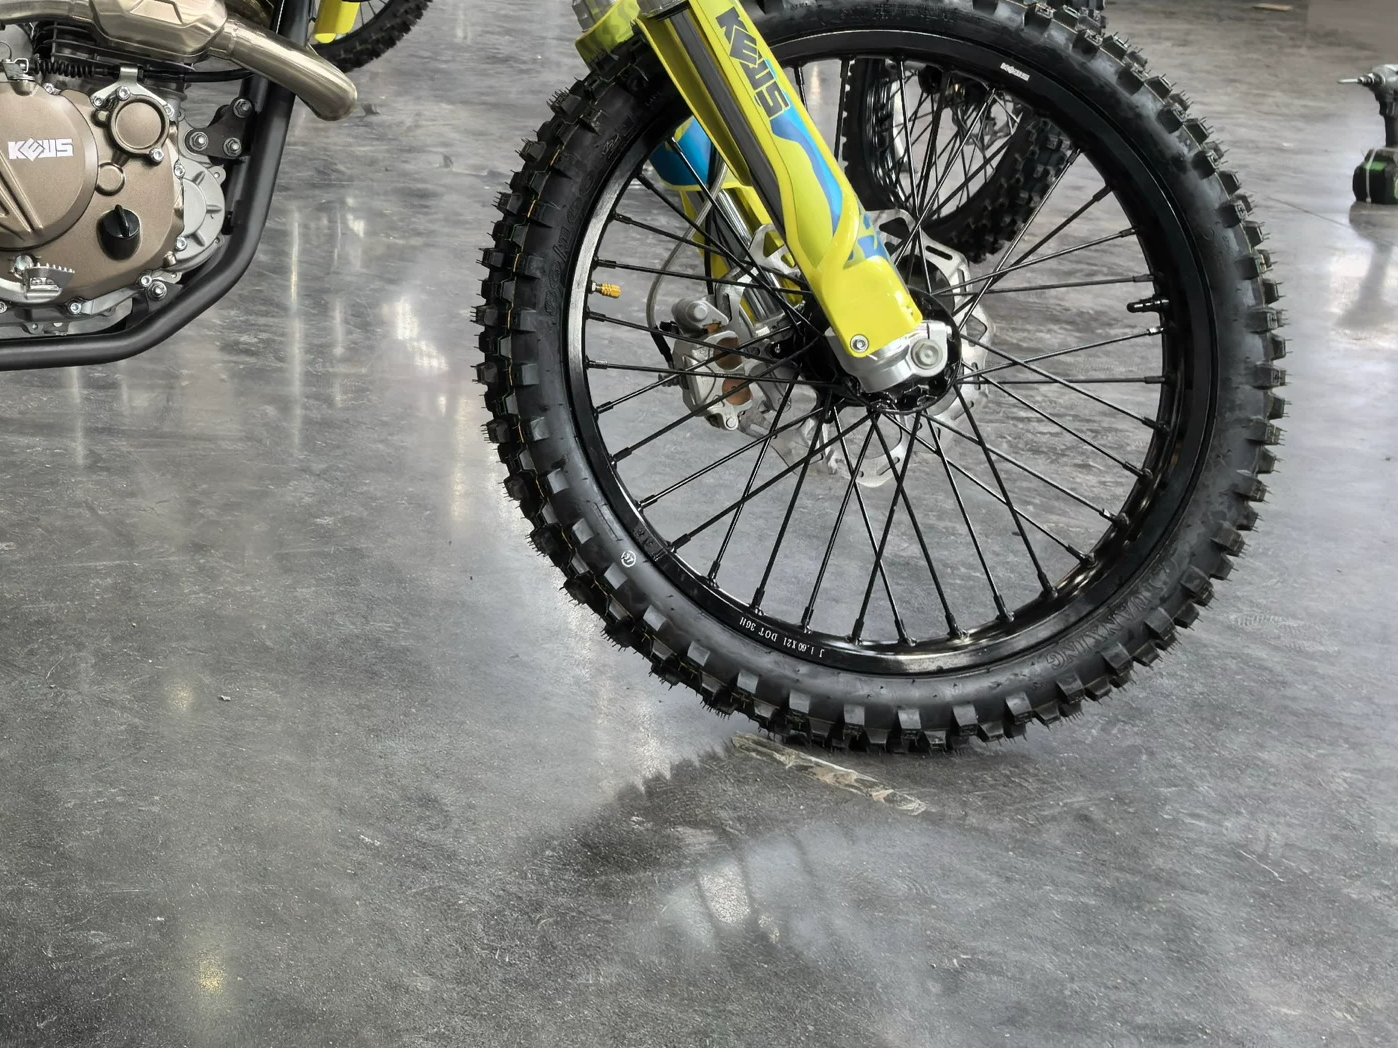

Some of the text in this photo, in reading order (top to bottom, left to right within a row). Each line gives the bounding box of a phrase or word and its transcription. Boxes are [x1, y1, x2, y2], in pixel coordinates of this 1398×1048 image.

[715, 7, 790, 120] KEWS
[7, 137, 74, 162] KEWS
[758, 627, 779, 642] DOT
